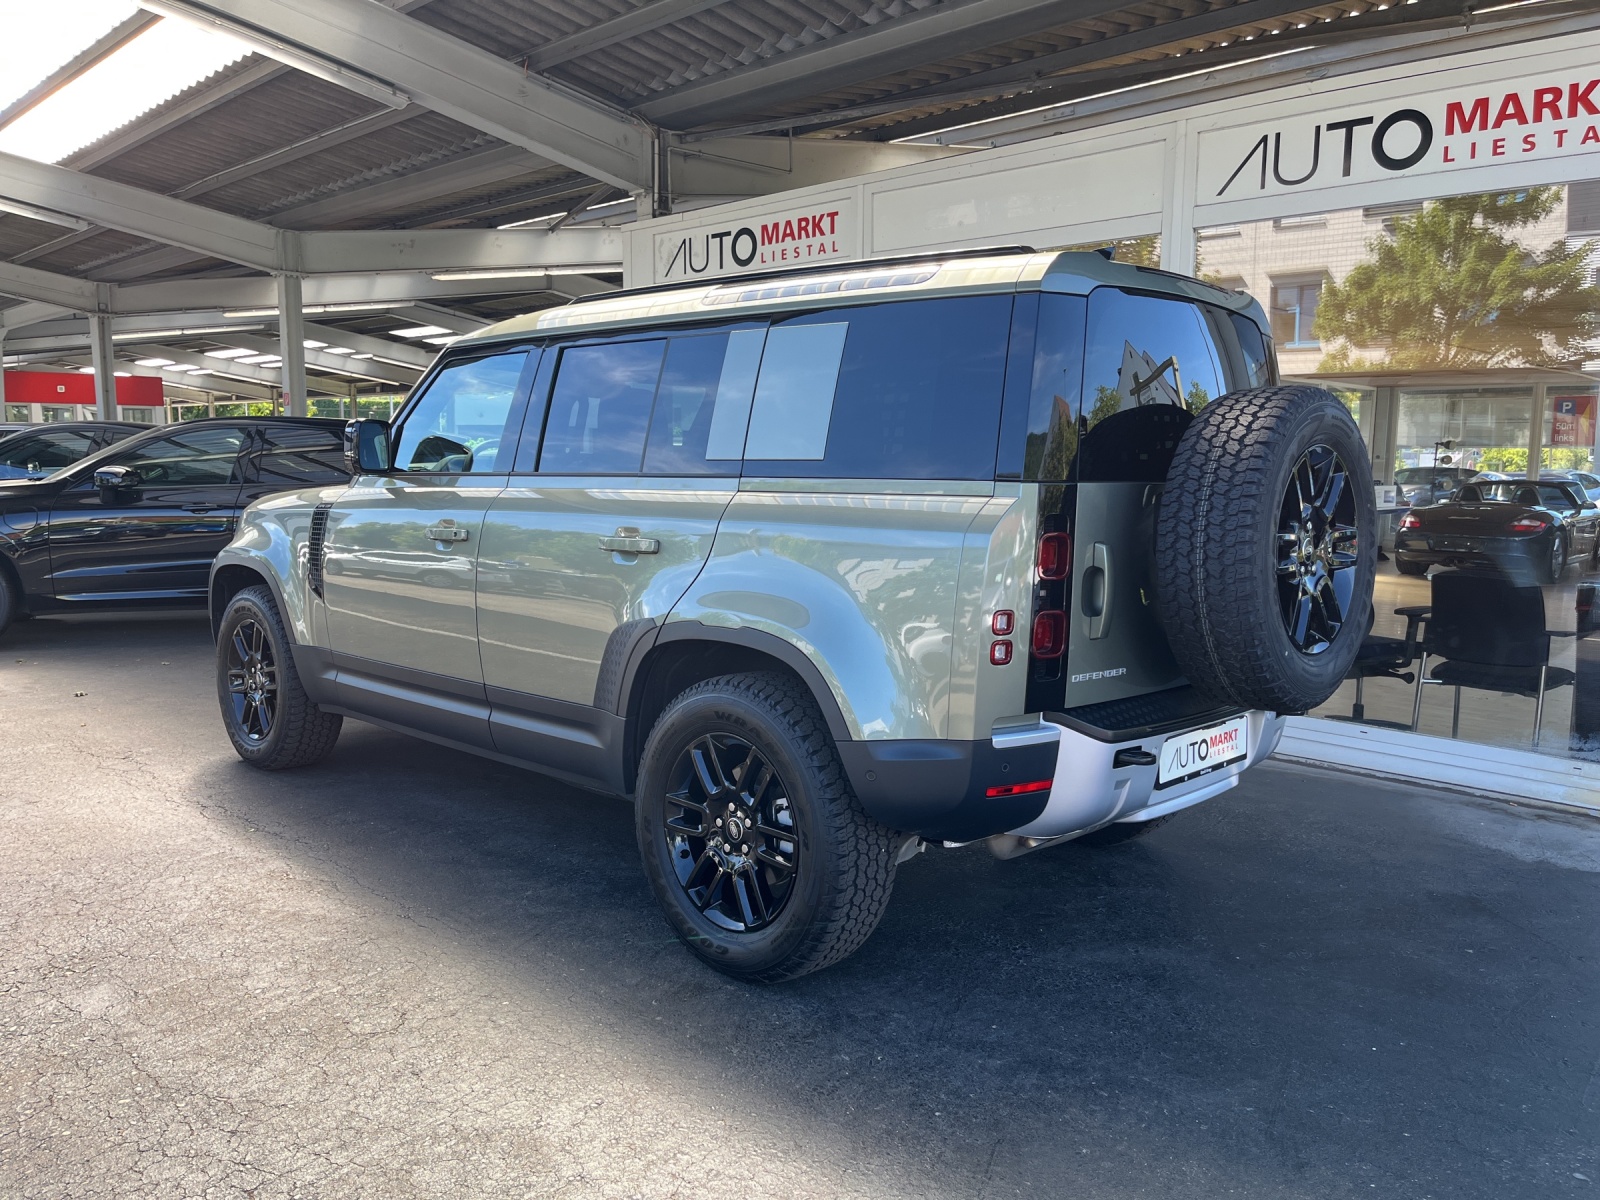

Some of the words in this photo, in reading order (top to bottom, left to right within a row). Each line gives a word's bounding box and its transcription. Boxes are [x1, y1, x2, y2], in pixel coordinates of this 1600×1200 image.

[1215, 108, 1434, 196] AUTO
[760, 211, 839, 246] MARKT
[664, 227, 758, 278] AUTO
[760, 240, 839, 264] LIESTAL
[1562, 402, 1572, 413] P
[1555, 422, 1575, 430] 50m
[1554, 434, 1574, 442] links
[1071, 667, 1127, 683] DEFENDER
[1209, 728, 1239, 749] MARKT
[1167, 738, 1209, 774] AUTO
[1209, 743, 1239, 759] LIESTAL
